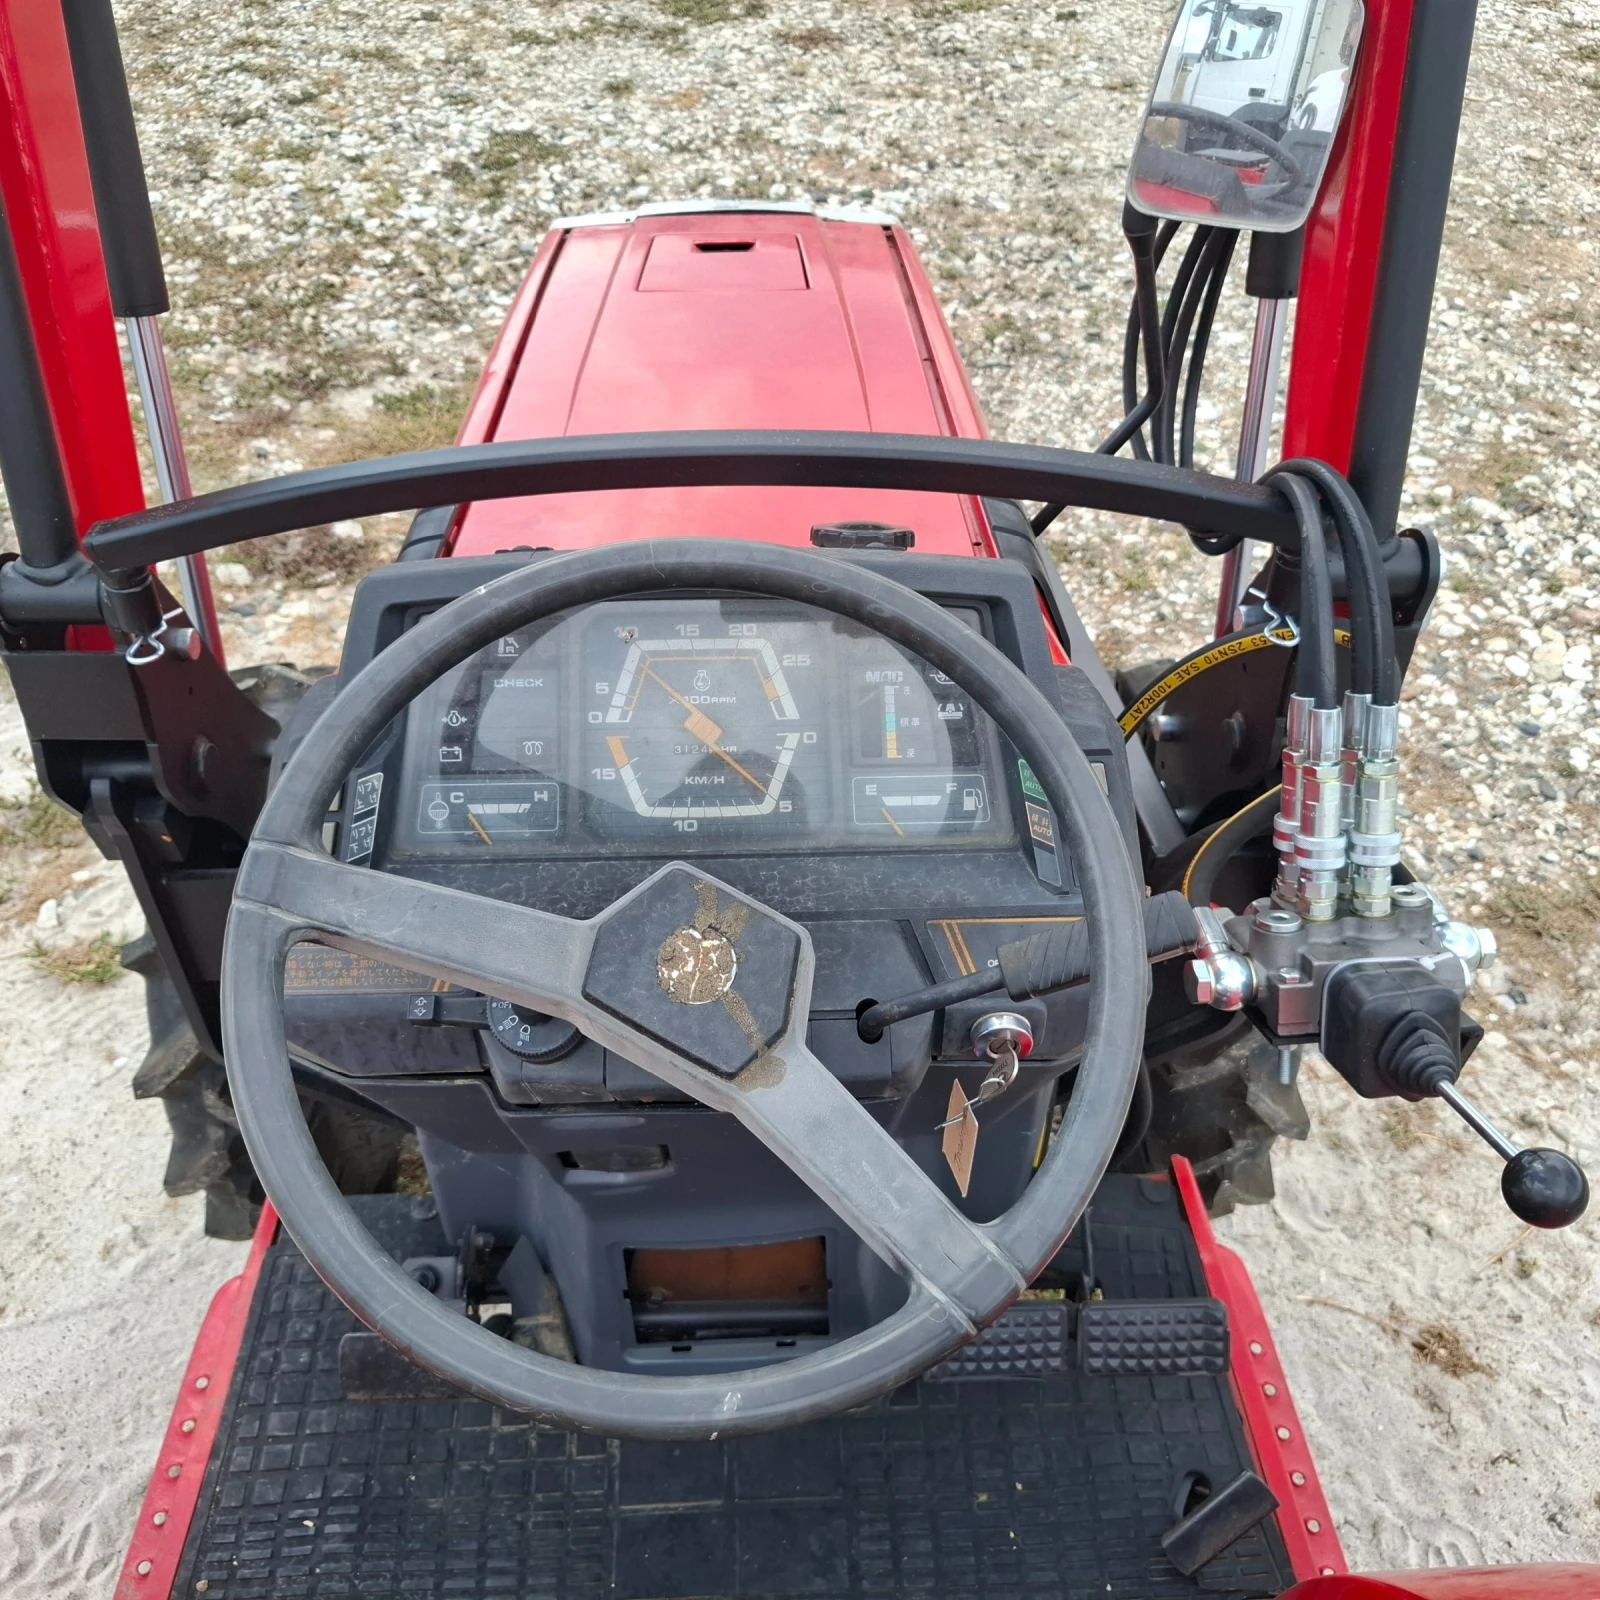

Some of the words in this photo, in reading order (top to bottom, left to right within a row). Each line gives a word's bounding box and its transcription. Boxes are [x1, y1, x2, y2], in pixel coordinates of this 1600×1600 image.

[676, 624, 699, 636] 15
[728, 623, 757, 636] 20
[1203, 641, 1243, 665] 2SN10
[783, 654, 810, 666] 25
[1173, 661, 1200, 682] SAE
[494, 678, 544, 688] CHECK
[595, 682, 609, 694] 5
[1129, 680, 1172, 728] 100R2AT
[588, 712, 602, 723] 0
[803, 732, 817, 743] 0
[591, 768, 615, 780] 15
[685, 776, 725, 785] KM/H
[358, 780, 379, 795] リフト
[866, 784, 877, 796] E
[946, 783, 957, 794] F
[450, 792, 464, 803] C
[534, 790, 548, 801] H
[779, 801, 792, 812] 5
[352, 824, 373, 840] リフト
[673, 820, 698, 832] 10
[1033, 824, 1053, 837] AUTO
